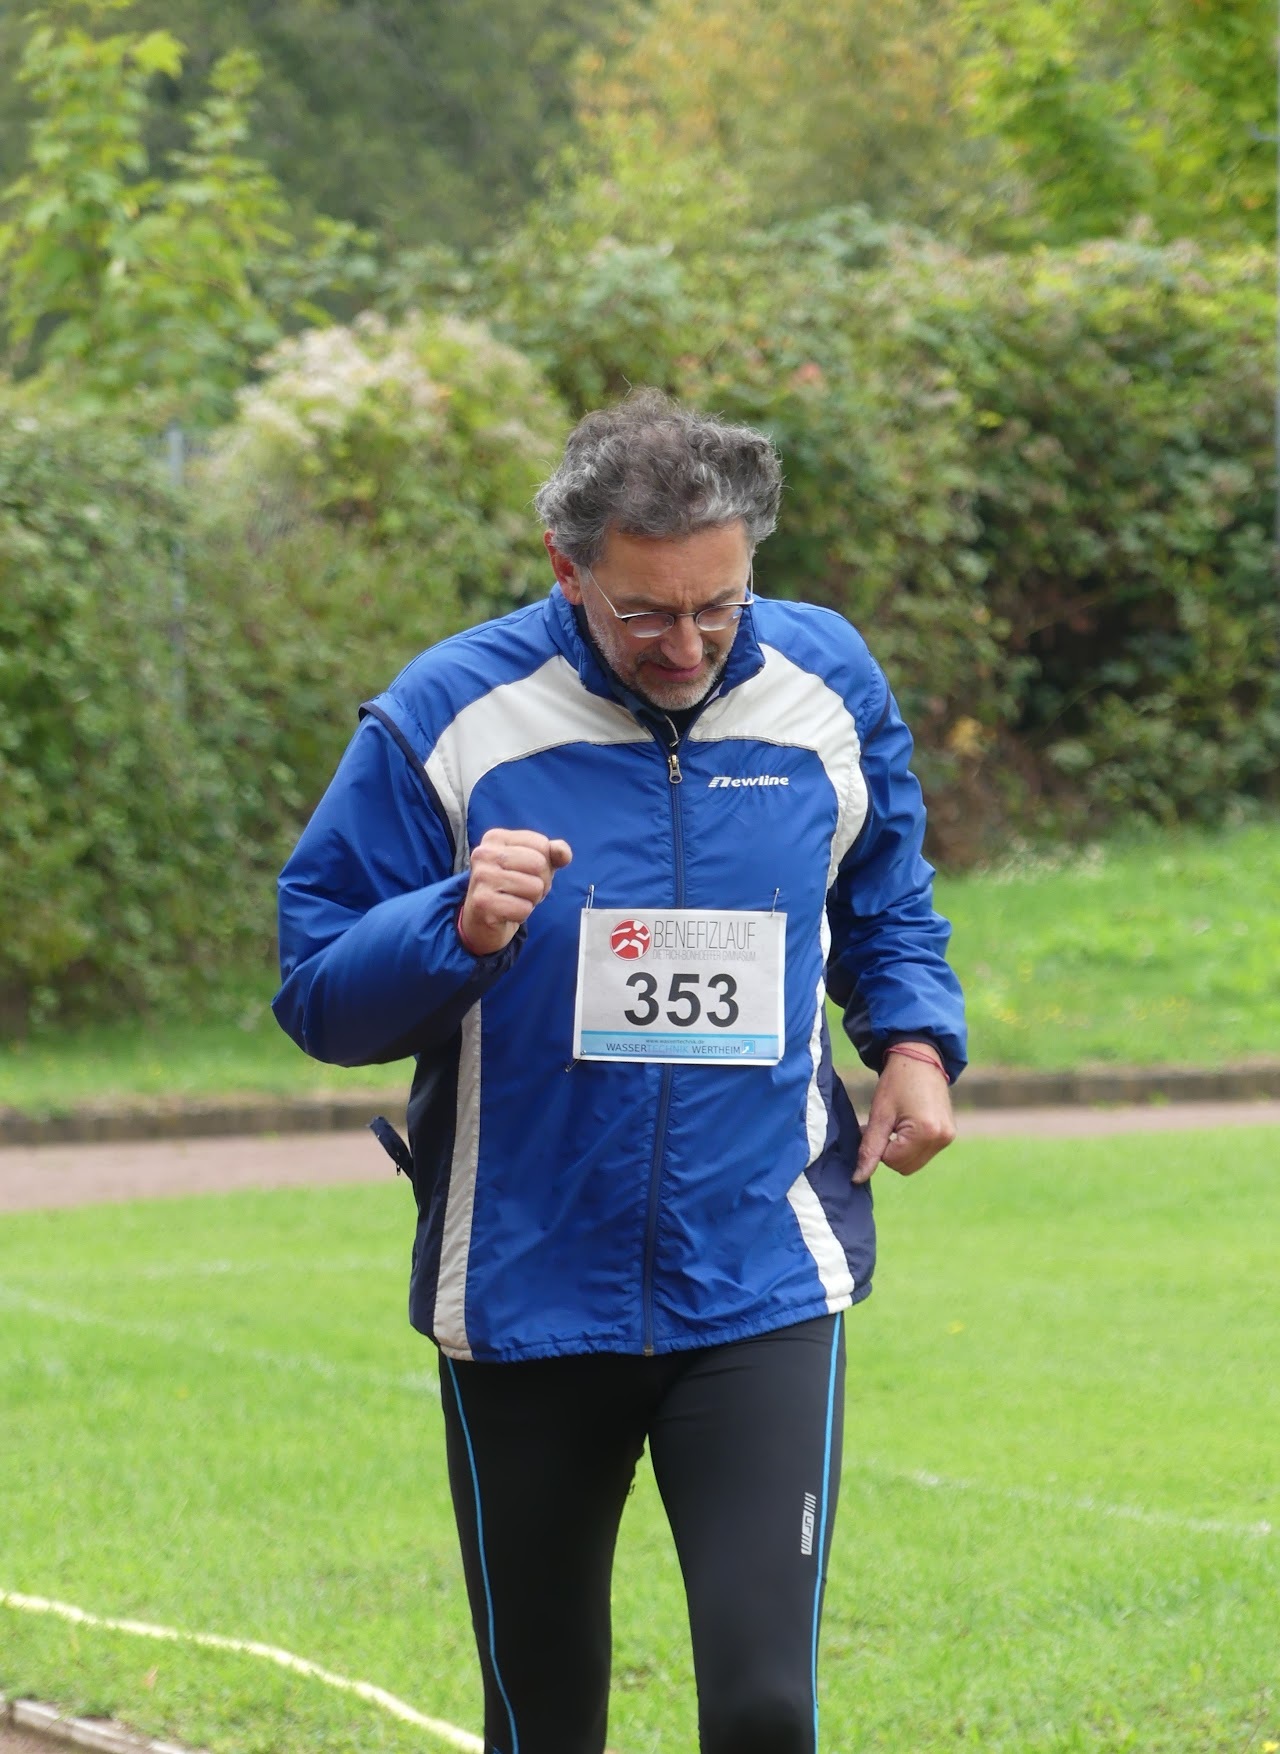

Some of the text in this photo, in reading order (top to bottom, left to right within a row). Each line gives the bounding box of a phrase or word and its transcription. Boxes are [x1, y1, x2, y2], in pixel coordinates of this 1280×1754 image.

[653, 920, 756, 950] BENEFIZLAUF
[722, 949, 757, 962] GYMNASIUM
[624, 971, 740, 1028] 353
[691, 1045, 741, 1054] WERTHEIM
